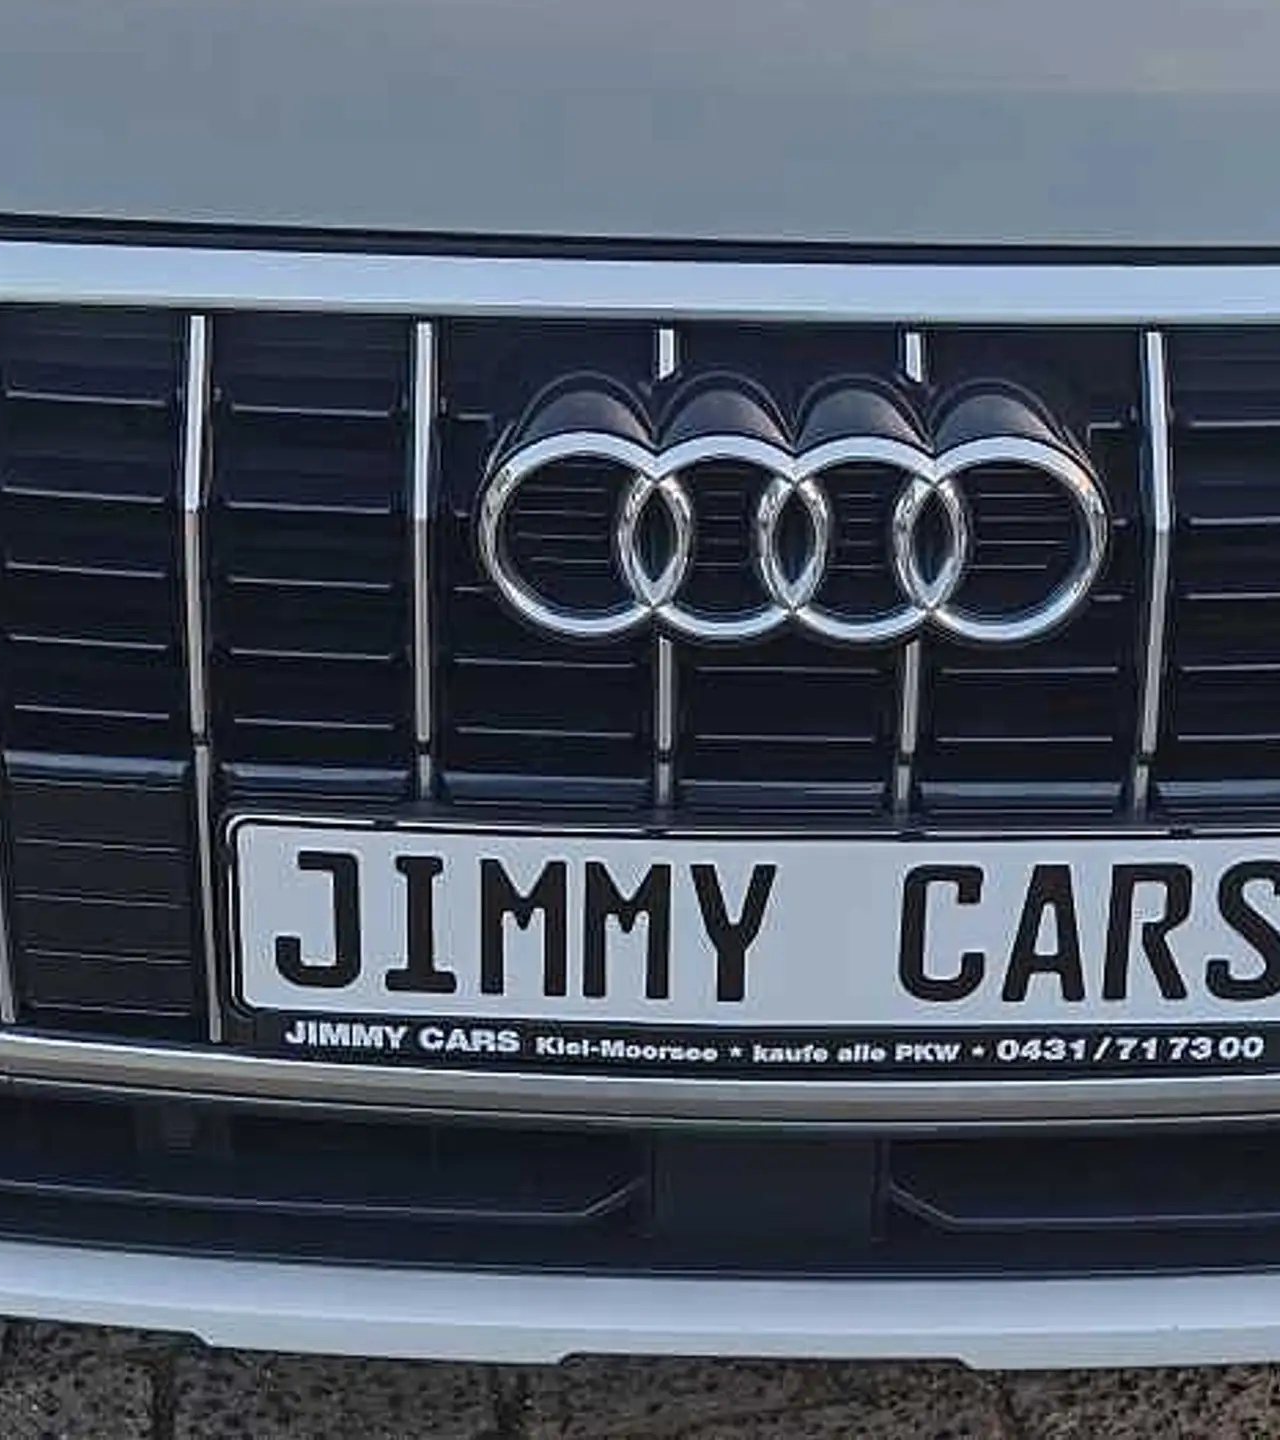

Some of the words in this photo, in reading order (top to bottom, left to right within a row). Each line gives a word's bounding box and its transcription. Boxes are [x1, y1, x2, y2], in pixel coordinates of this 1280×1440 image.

[274, 849, 778, 1004] JIMMY
[285, 1021, 408, 1051] JIMMY
[419, 1028, 520, 1054] CARS
[535, 1035, 719, 1063] Kiel-Moorsee
[753, 1043, 828, 1063] kaufe
[837, 1044, 887, 1062] alle
[894, 1044, 961, 1063] PKW
